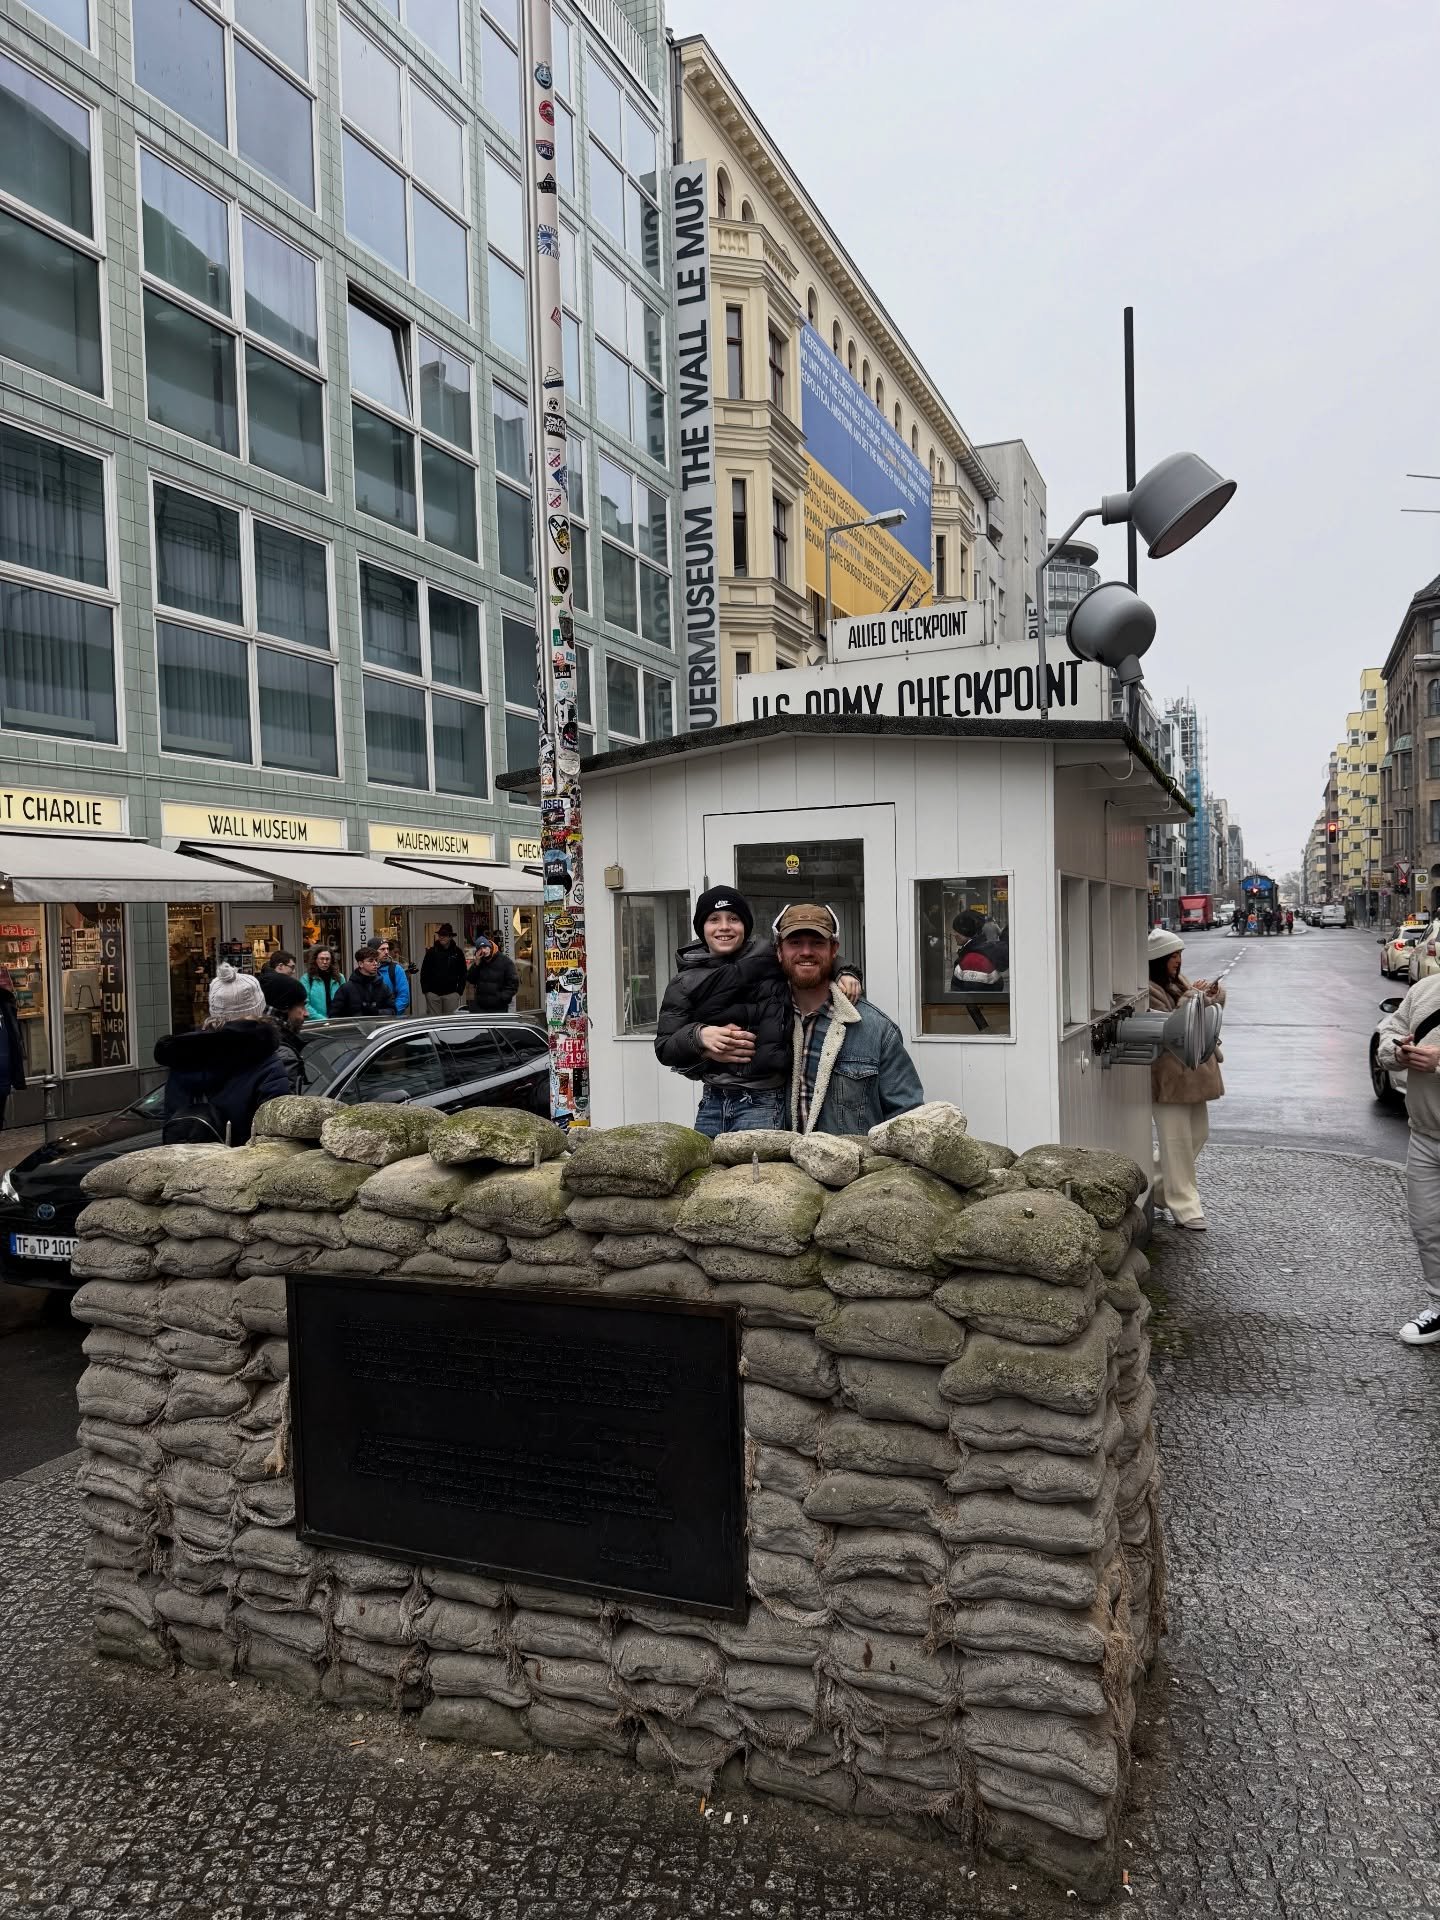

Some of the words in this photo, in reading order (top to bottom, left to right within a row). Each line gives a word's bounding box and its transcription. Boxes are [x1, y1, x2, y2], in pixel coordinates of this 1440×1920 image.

[675, 173, 704, 260] MUR
[677, 267, 706, 306] LE
[679, 319, 708, 419] WALL
[681, 425, 710, 491] THE
[848, 621, 885, 649] ALLIED
[891, 610, 967, 644] CHECKPOINT
[898, 660, 1082, 718] CHECKPOINT
[23, 796, 102, 825] CHARLIE
[208, 814, 248, 837] WALL
[252, 818, 308, 841] MUSEUM
[396, 831, 469, 854] MAUERMUSEUM
[16, 1237, 29, 1253] TF
[35, 1238, 50, 1254] TP
